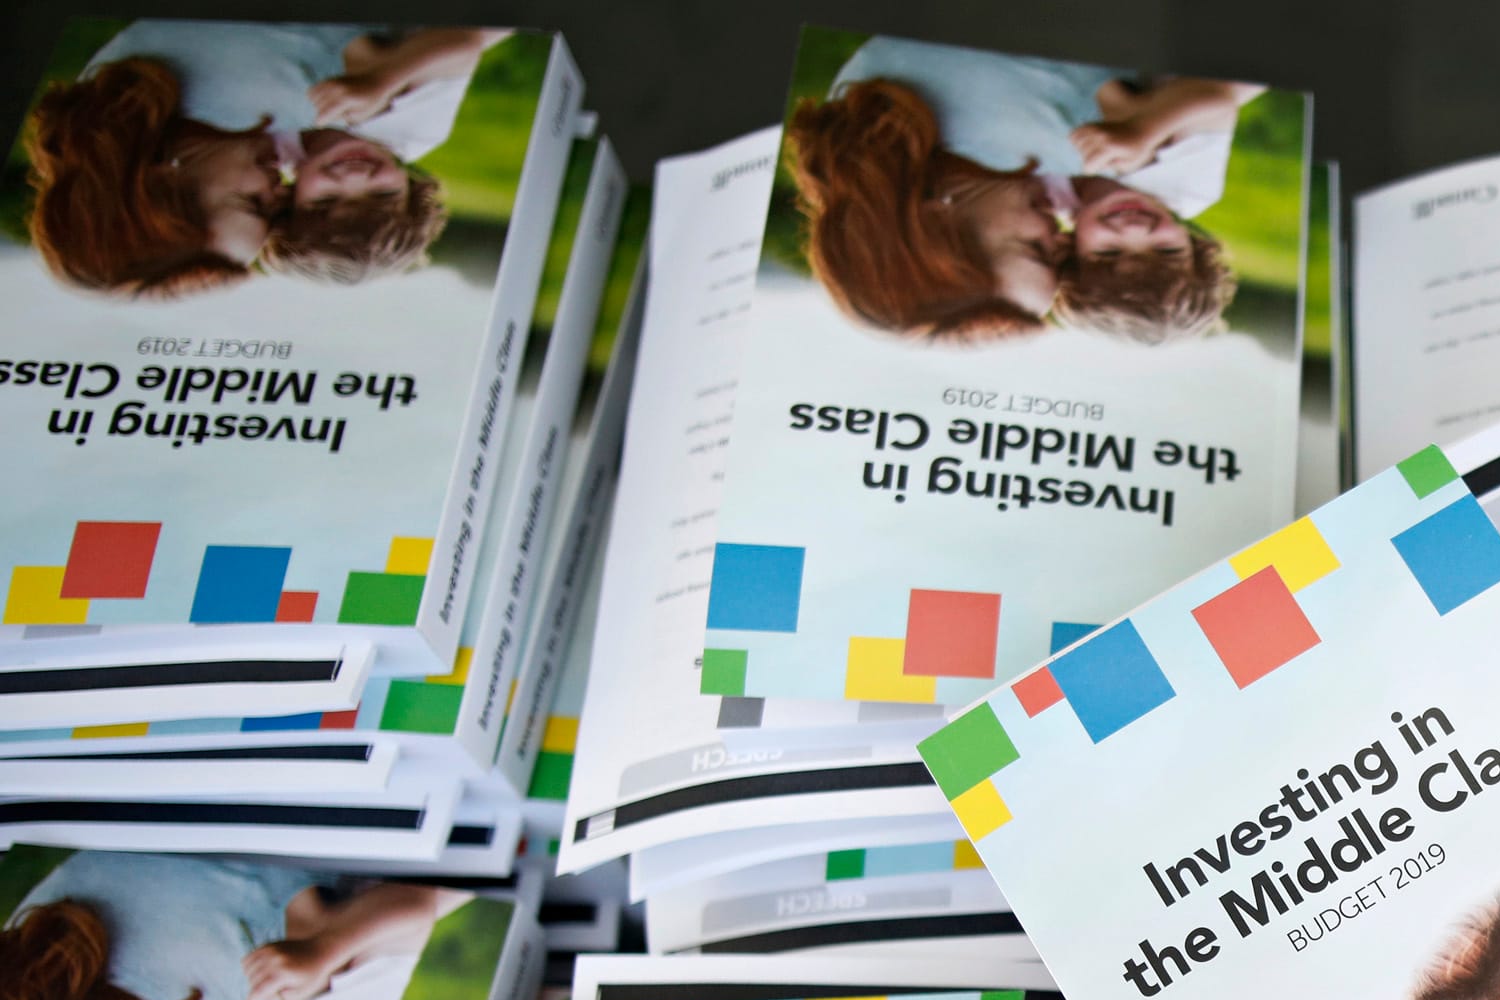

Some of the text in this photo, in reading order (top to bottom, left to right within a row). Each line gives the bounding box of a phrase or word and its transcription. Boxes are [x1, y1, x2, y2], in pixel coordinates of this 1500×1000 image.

[137, 337, 292, 360] BUDGET 2019
[136, 365, 318, 404] Middle
[332, 372, 418, 410] the
[941, 387, 1105, 421] BUDGET 2019
[47, 401, 347, 453] Investing in
[789, 402, 1242, 484] the Middle Class
[861, 456, 1175, 527] Investing in
[1142, 705, 1456, 908] Investing in
[1122, 925, 1221, 998] the
[1218, 805, 1416, 939] Middle
[1286, 842, 1447, 953] BUDGET 2019
